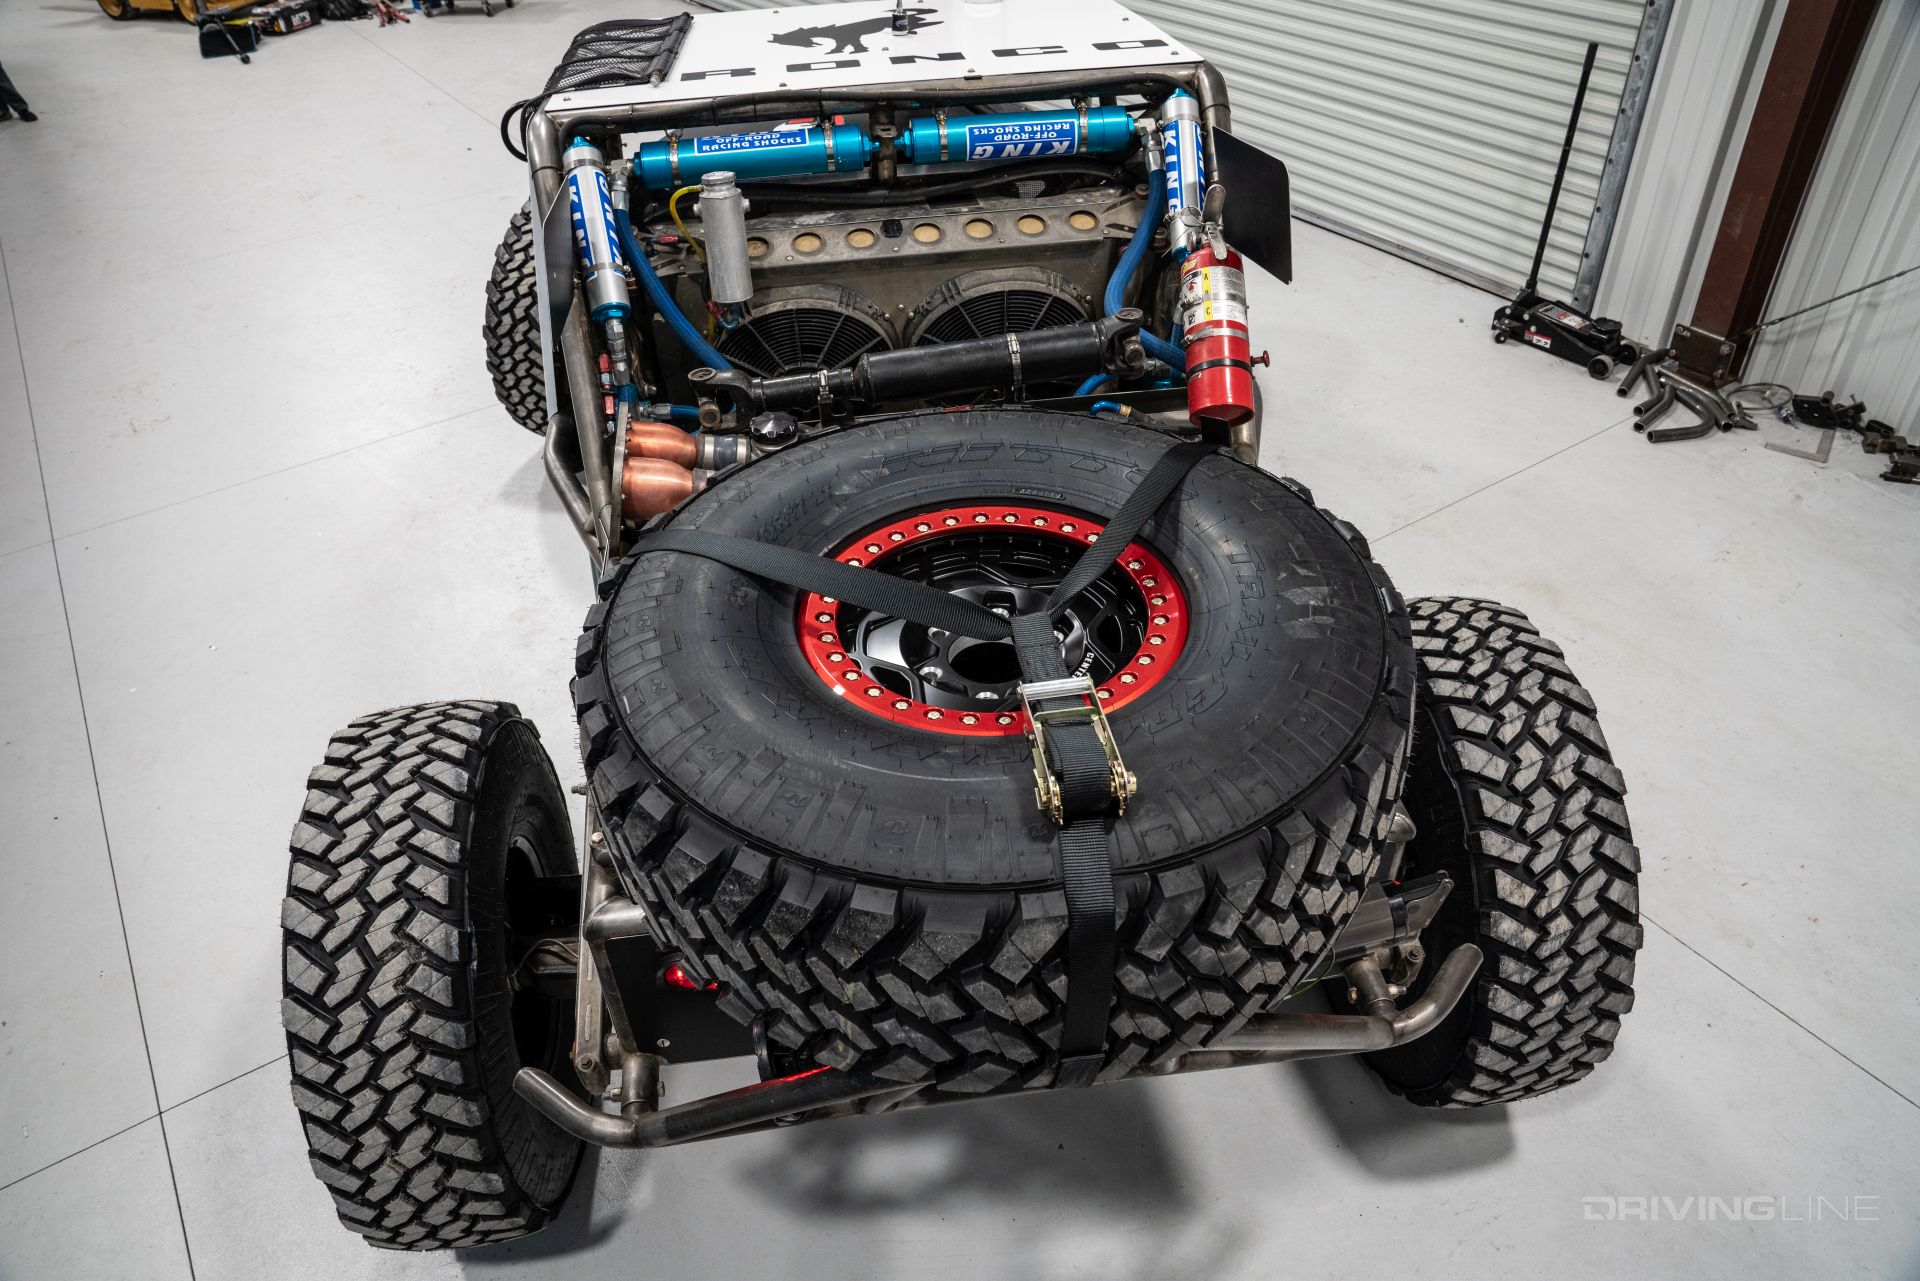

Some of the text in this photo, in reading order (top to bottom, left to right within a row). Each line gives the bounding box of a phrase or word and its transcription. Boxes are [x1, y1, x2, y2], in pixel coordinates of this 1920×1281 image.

[680, 38, 1169, 82] RONCO
[973, 123, 1070, 135] RACING SHOCKS
[715, 132, 781, 144] OFF-ROAD
[994, 131, 1057, 141] OFF-ROAD
[702, 136, 802, 151] RACING SHOCKS
[972, 141, 1070, 159] KING
